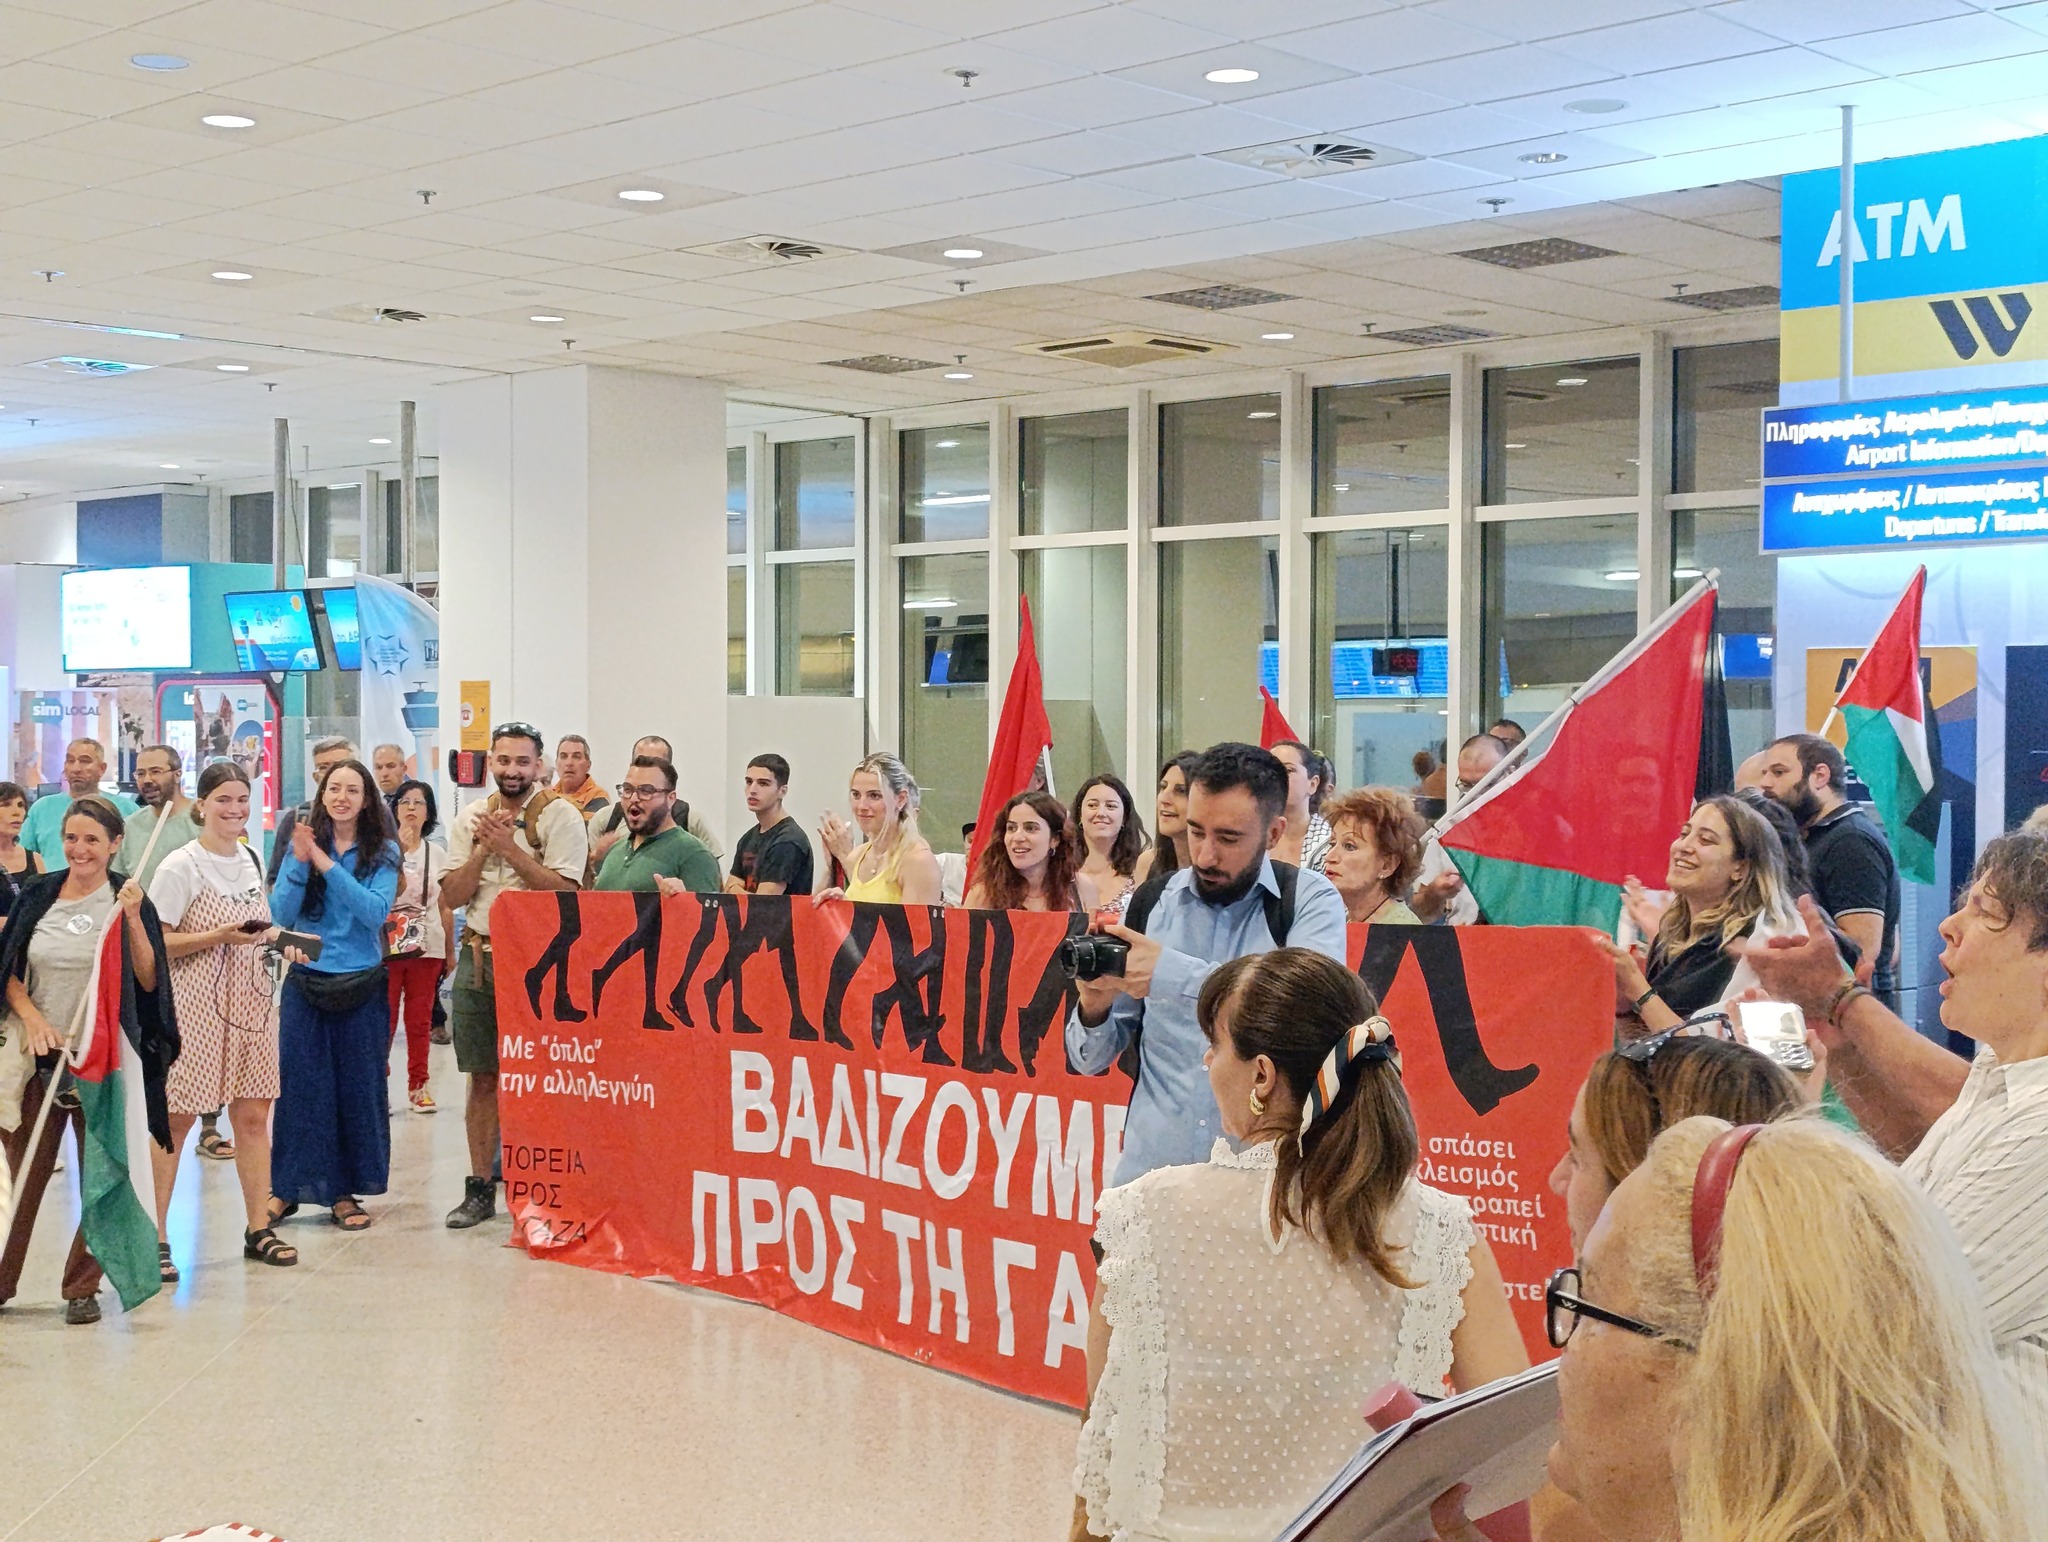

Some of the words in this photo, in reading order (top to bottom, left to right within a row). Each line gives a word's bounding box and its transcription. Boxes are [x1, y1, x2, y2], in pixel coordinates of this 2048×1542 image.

[1816, 193, 1967, 268] ATM
[1766, 414, 1881, 444] Πληροφορίες
[1845, 443, 1908, 468] Airport
[1885, 516, 1977, 540] Departures
[32, 701, 61, 716] sim
[65, 706, 102, 716] LOCAL
[502, 1034, 535, 1060] Με
[500, 1071, 537, 1097] την
[543, 1068, 655, 1109] αλληλεγγύη
[1428, 1132, 1517, 1160] σπάσει
[690, 1170, 865, 1311] ΠΡΟΣ
[881, 1211, 971, 1344] ΤΗ
